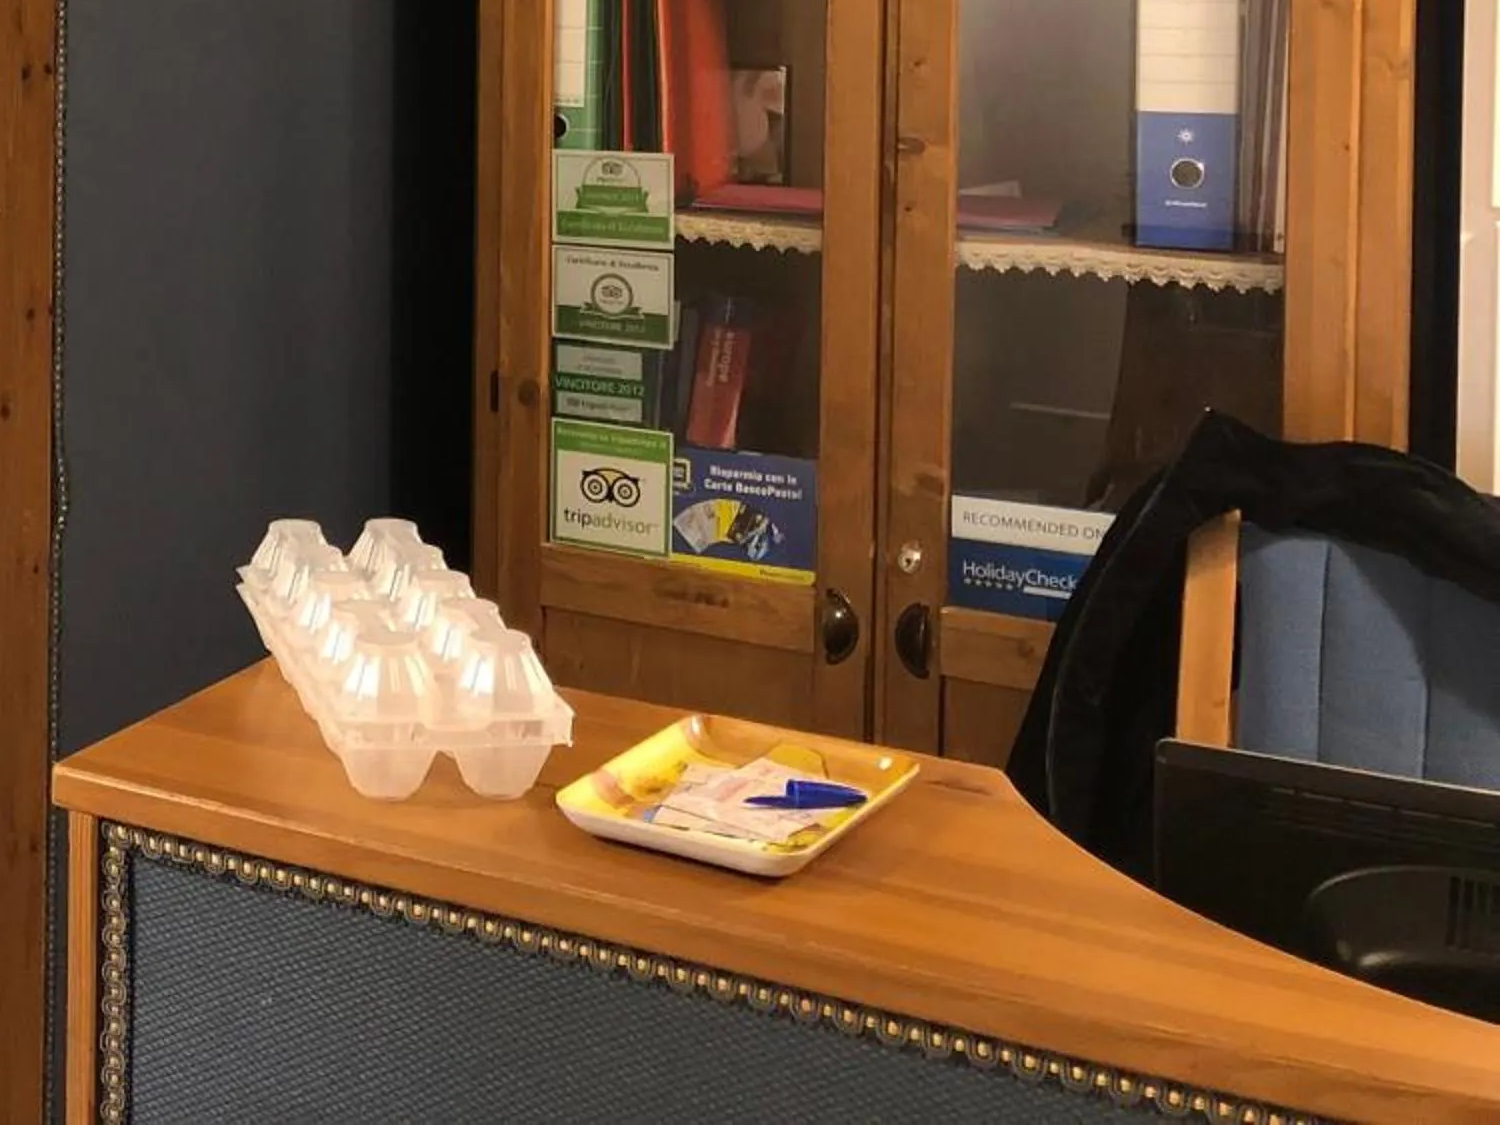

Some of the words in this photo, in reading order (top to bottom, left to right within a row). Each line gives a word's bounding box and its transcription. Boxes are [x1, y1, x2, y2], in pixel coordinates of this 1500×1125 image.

[555, 375, 618, 394] VINCITORE
[619, 383, 645, 397] 2012
[704, 478, 733, 492] Carta
[709, 464, 763, 482] Risparmia
[765, 474, 785, 484] con
[787, 474, 797, 485] la
[563, 507, 654, 535] tripadvisor
[963, 510, 1080, 537] RECOMMENDED
[1083, 527, 1106, 541] ON
[963, 559, 1079, 590] HolidayCheck
